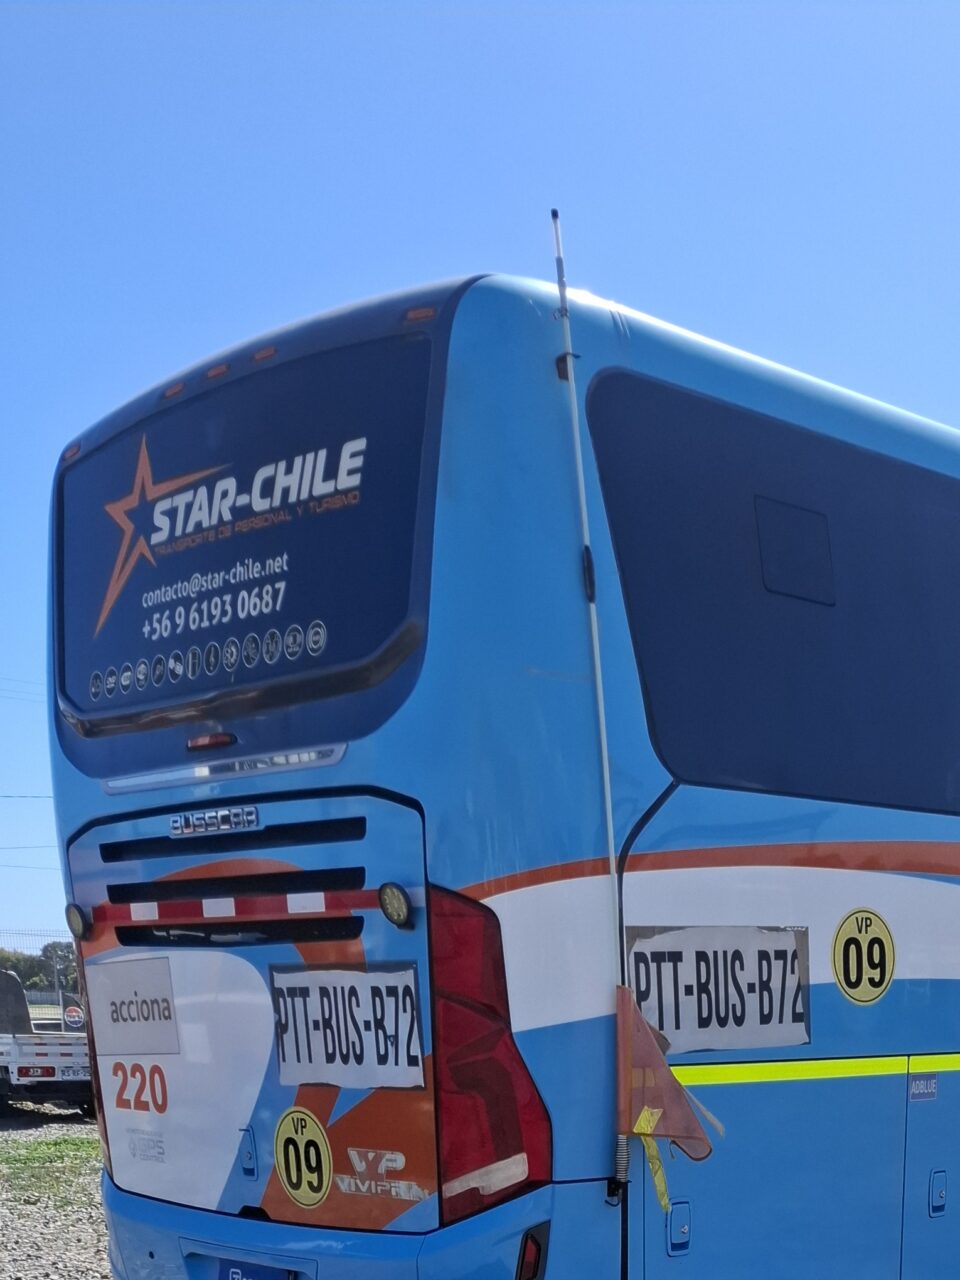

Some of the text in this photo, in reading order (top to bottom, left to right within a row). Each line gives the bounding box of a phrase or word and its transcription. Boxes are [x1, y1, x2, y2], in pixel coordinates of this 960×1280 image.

[150, 437, 367, 545] STAR-CHILE
[154, 531, 216, 556] TRANSPORTE
[218, 525, 232, 540] DE
[234, 510, 292, 534] PERSONAL
[309, 491, 360, 514] TURISMO
[142, 552, 289, 608] contacto@star-chile.net
[142, 581, 287, 641] +56 9 6193 0687
[170, 806, 259, 835] BUSSCAR
[855, 916, 873, 935] VP
[633, 949, 805, 1031] PTT-BUS-B72
[842, 936, 887, 990] 09
[110, 990, 173, 1023] acciona
[275, 984, 420, 1068] PTT-BUS-B72
[111, 1061, 168, 1114] 220
[911, 1079, 937, 1094] ADBLUE
[292, 1116, 308, 1135] VP
[283, 1136, 324, 1194] 09
